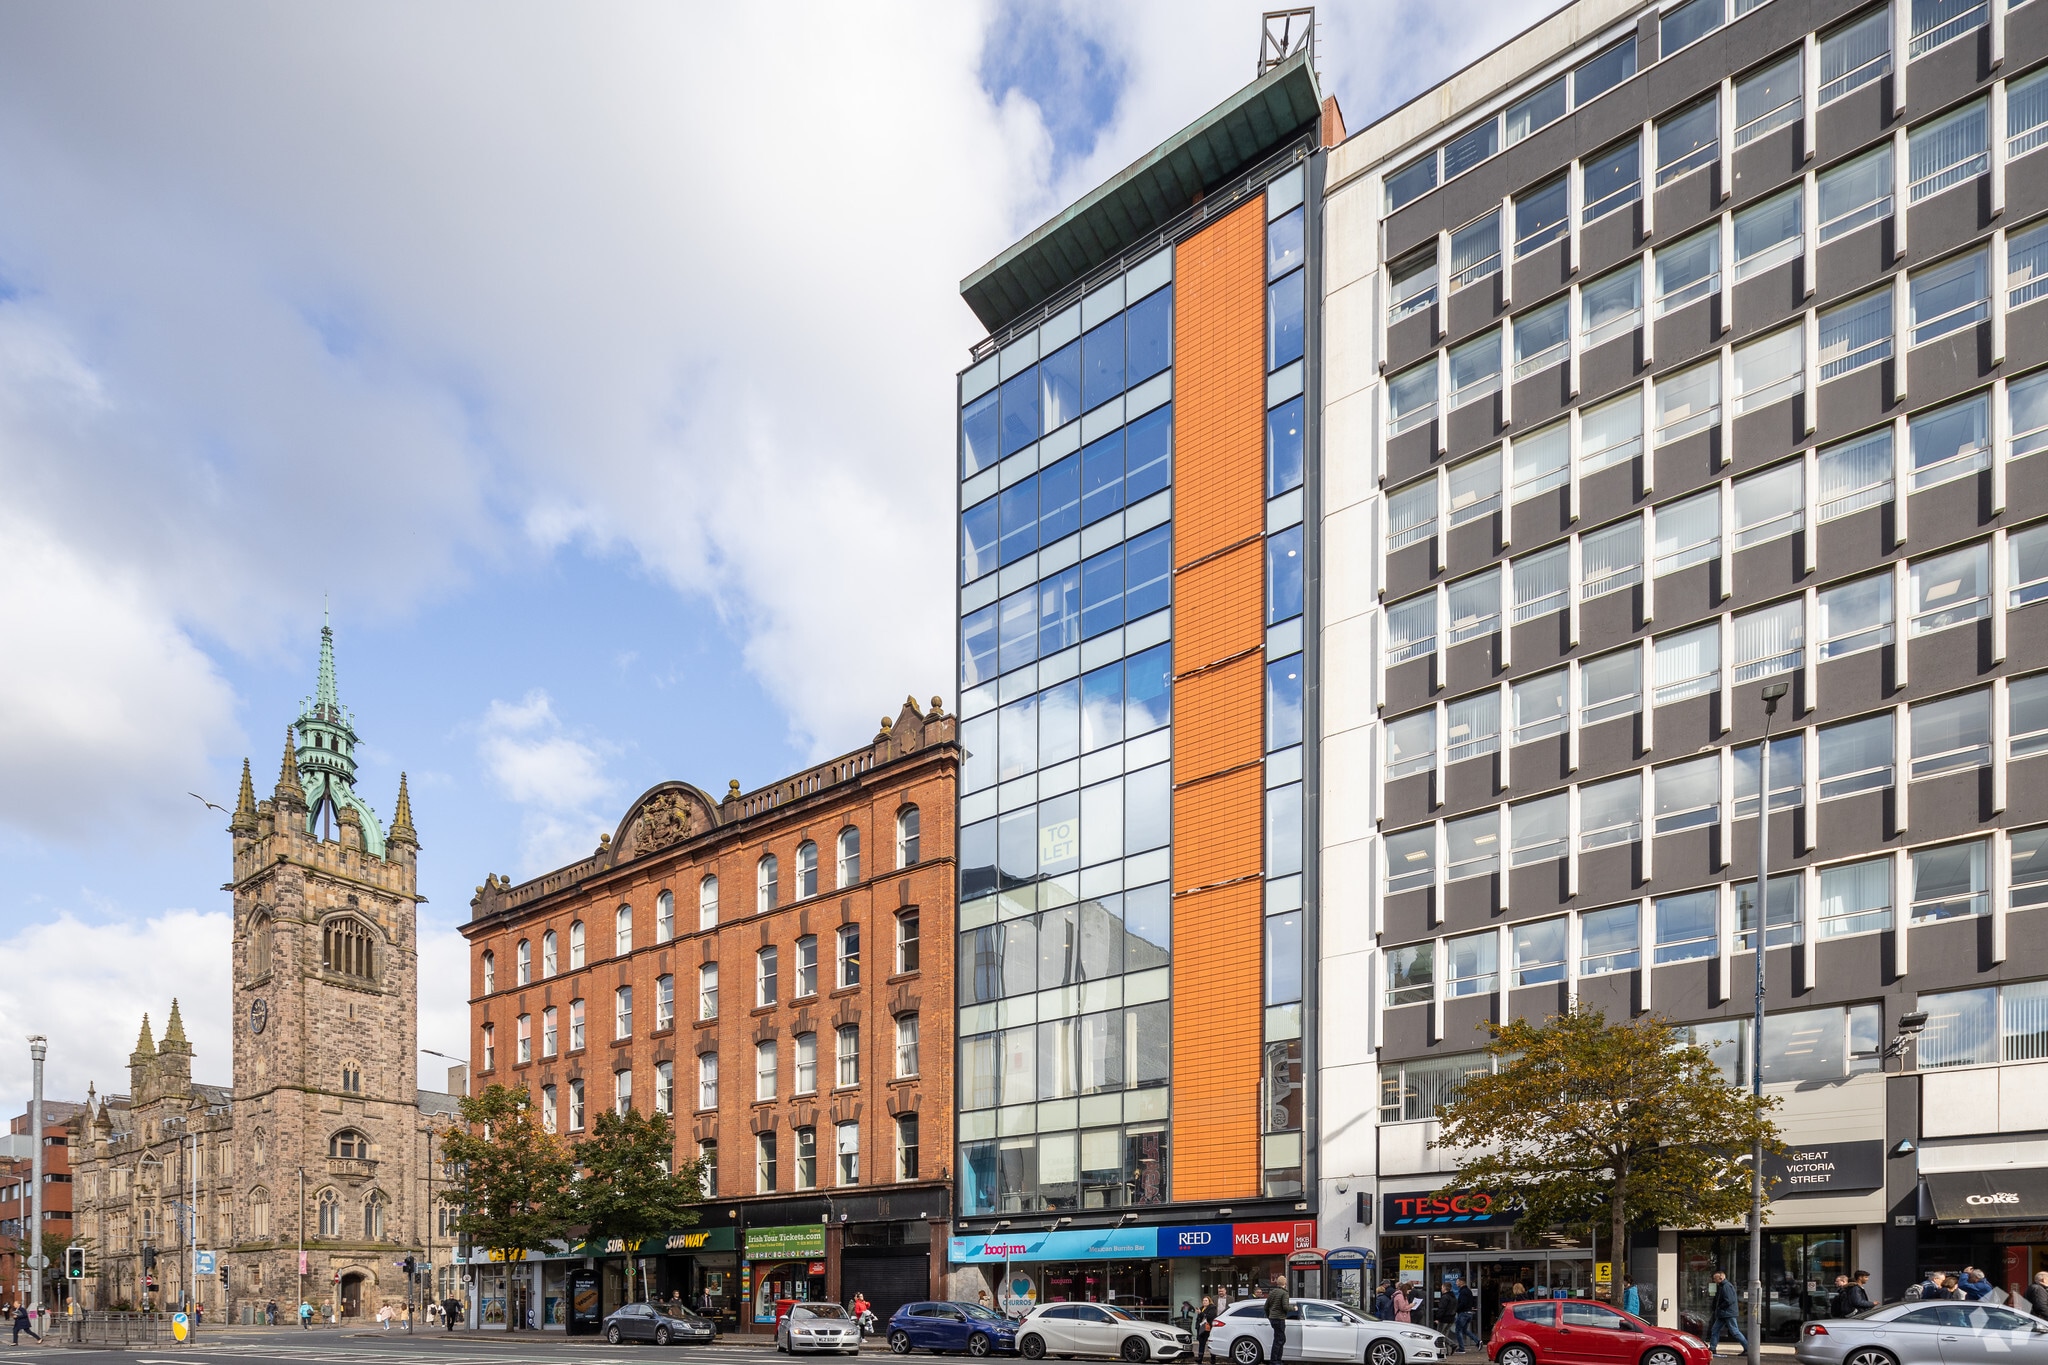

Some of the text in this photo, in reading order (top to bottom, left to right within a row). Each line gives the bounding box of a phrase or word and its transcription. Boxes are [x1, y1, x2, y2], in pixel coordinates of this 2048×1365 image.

[1048, 824, 1070, 842] TO
[1043, 840, 1073, 861] LET
[1793, 1151, 1829, 1161] GREAT
[1785, 1162, 1835, 1173] VICTORIA
[1790, 1174, 1832, 1184] STREET
[1395, 1193, 1492, 1215] TESCO
[1966, 1194, 2020, 1205] Coke
[665, 1230, 712, 1250] SUBWAY
[748, 1232, 821, 1243] Irish Tour Tickets.com
[1178, 1231, 1211, 1245] REED
[1235, 1232, 1290, 1245] MKB LAW
[1088, 1245, 1113, 1253] Mexican
[1239, 1273, 1249, 1281] 14
